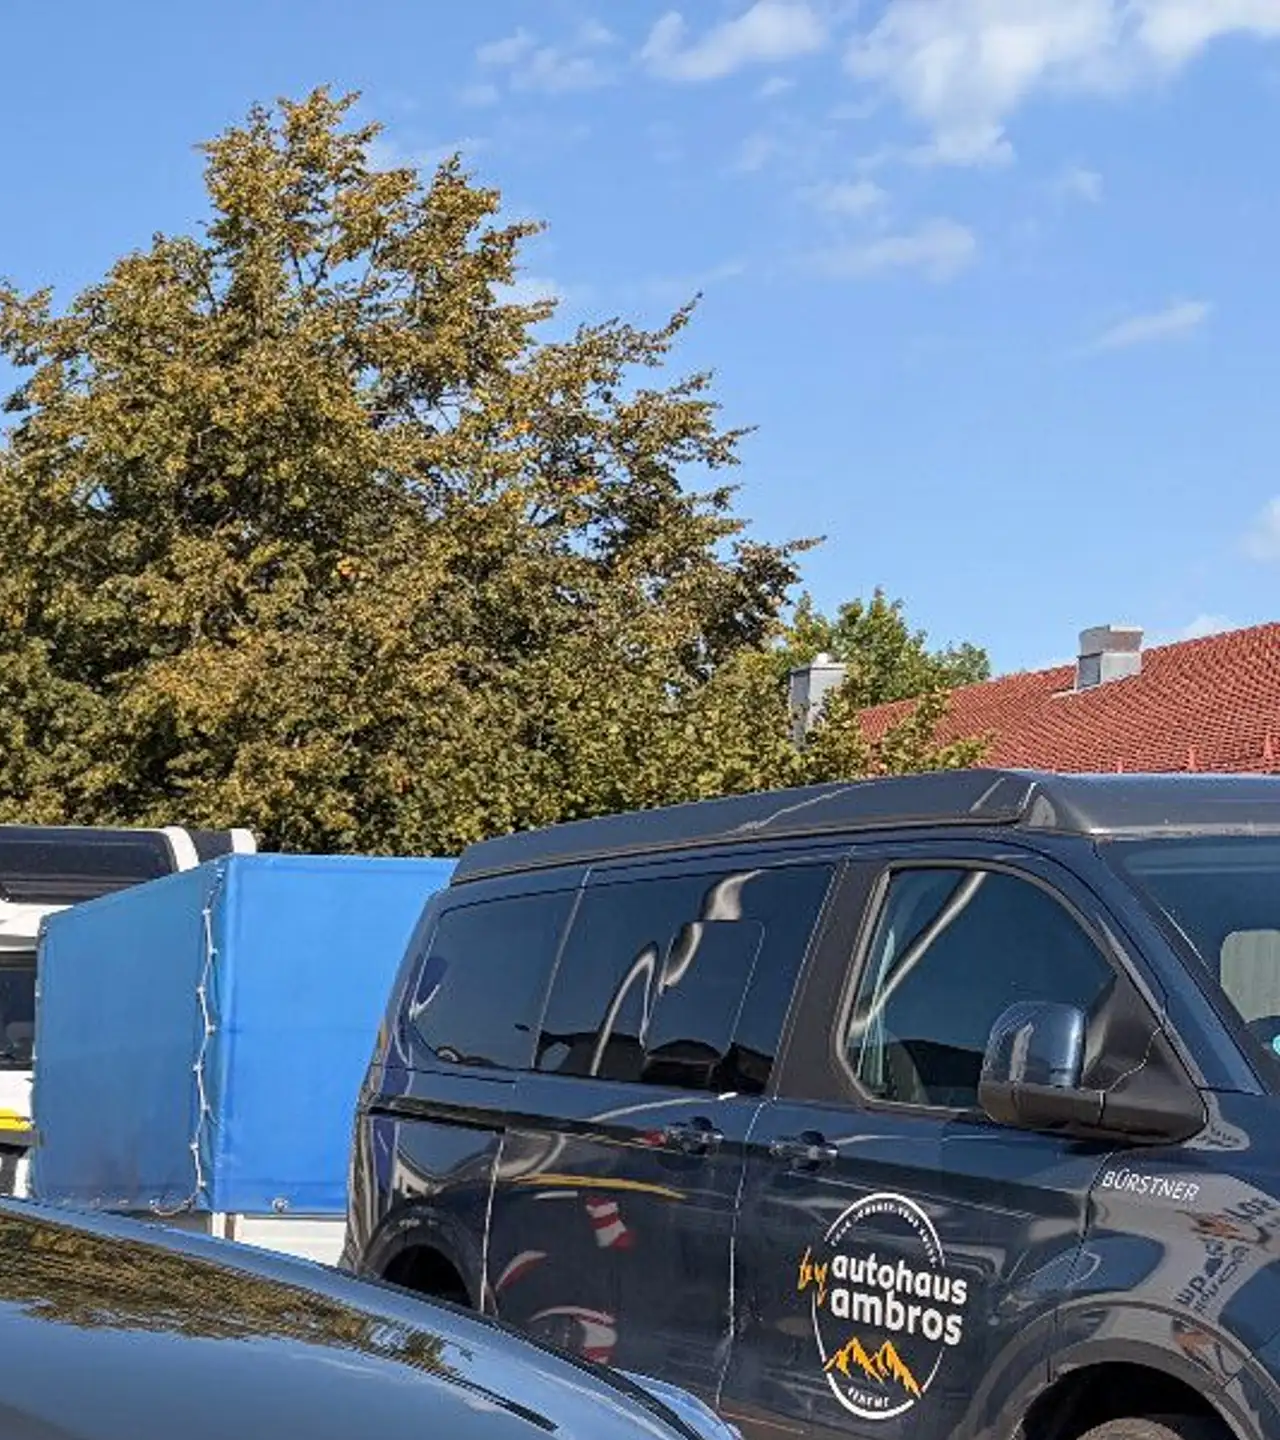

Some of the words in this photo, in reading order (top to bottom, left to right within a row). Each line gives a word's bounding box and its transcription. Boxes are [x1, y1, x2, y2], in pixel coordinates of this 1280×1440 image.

[1101, 1168, 1200, 1201] BÜRSTNER
[831, 1253, 968, 1305] autohaus
[830, 1288, 963, 1346] ambros
